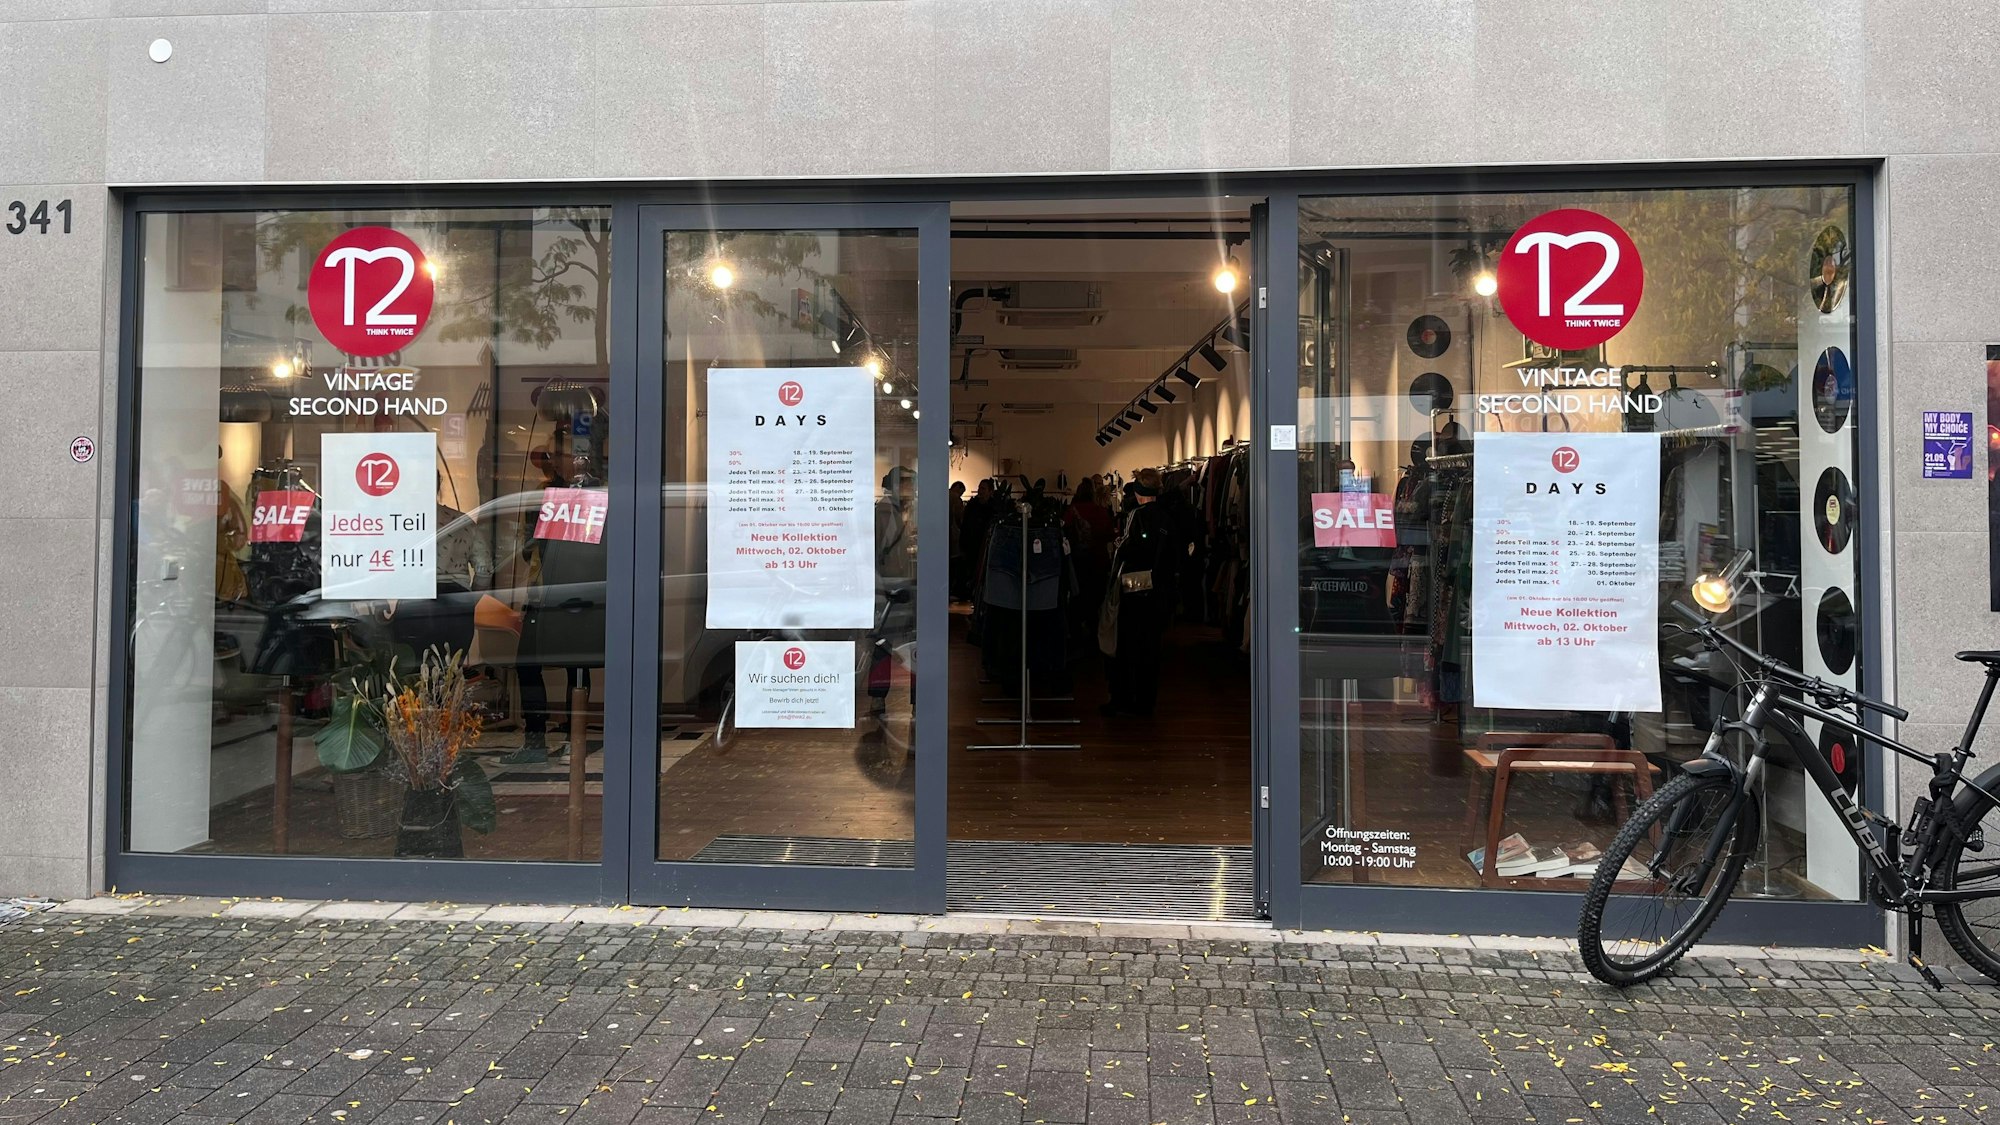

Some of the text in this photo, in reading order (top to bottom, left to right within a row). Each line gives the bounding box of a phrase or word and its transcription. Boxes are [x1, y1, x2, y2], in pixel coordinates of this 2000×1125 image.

[6, 199, 72, 235] 341
[1565, 319, 1620, 327] THINK TWICE
[366, 328, 413, 336] THINK TWICE
[324, 373, 414, 391] VINTAGE
[1517, 368, 1622, 387] VINTAGE
[289, 397, 448, 416] SECOND HAND
[1478, 394, 1663, 414] SECOND HAND
[755, 415, 827, 426] DAYS
[1924, 413, 1963, 424] MY BODY,
[1924, 423, 1969, 434] MY CHOICE
[1925, 453, 1946, 462] 21.09.
[1526, 482, 1606, 495] DAYS
[253, 505, 311, 526] SALE
[539, 501, 607, 526] SALE
[1314, 508, 1394, 530] SALE
[329, 513, 426, 533] Jedes Teil
[751, 533, 838, 541] Neue Kollektion
[736, 547, 847, 556] Mittwoch, 02. Oktober
[331, 549, 424, 568] nur 4€ !!!
[765, 561, 818, 569] ab 13 Uhr
[1520, 607, 1617, 618] Neue Kollektion
[1504, 621, 1628, 632] Mittwoch, 02. Oktober
[1537, 637, 1596, 646] ab 13 Uhr
[748, 673, 840, 683] Wir suchen dich!
[1325, 825, 1410, 842] Öffnungszeiten:
[1831, 787, 1893, 869] CUBE
[1320, 841, 1362, 856] Montag
[1371, 842, 1416, 857] Samstag
[1323, 855, 1352, 866] 10:00
[1393, 857, 1415, 868] Uhr
